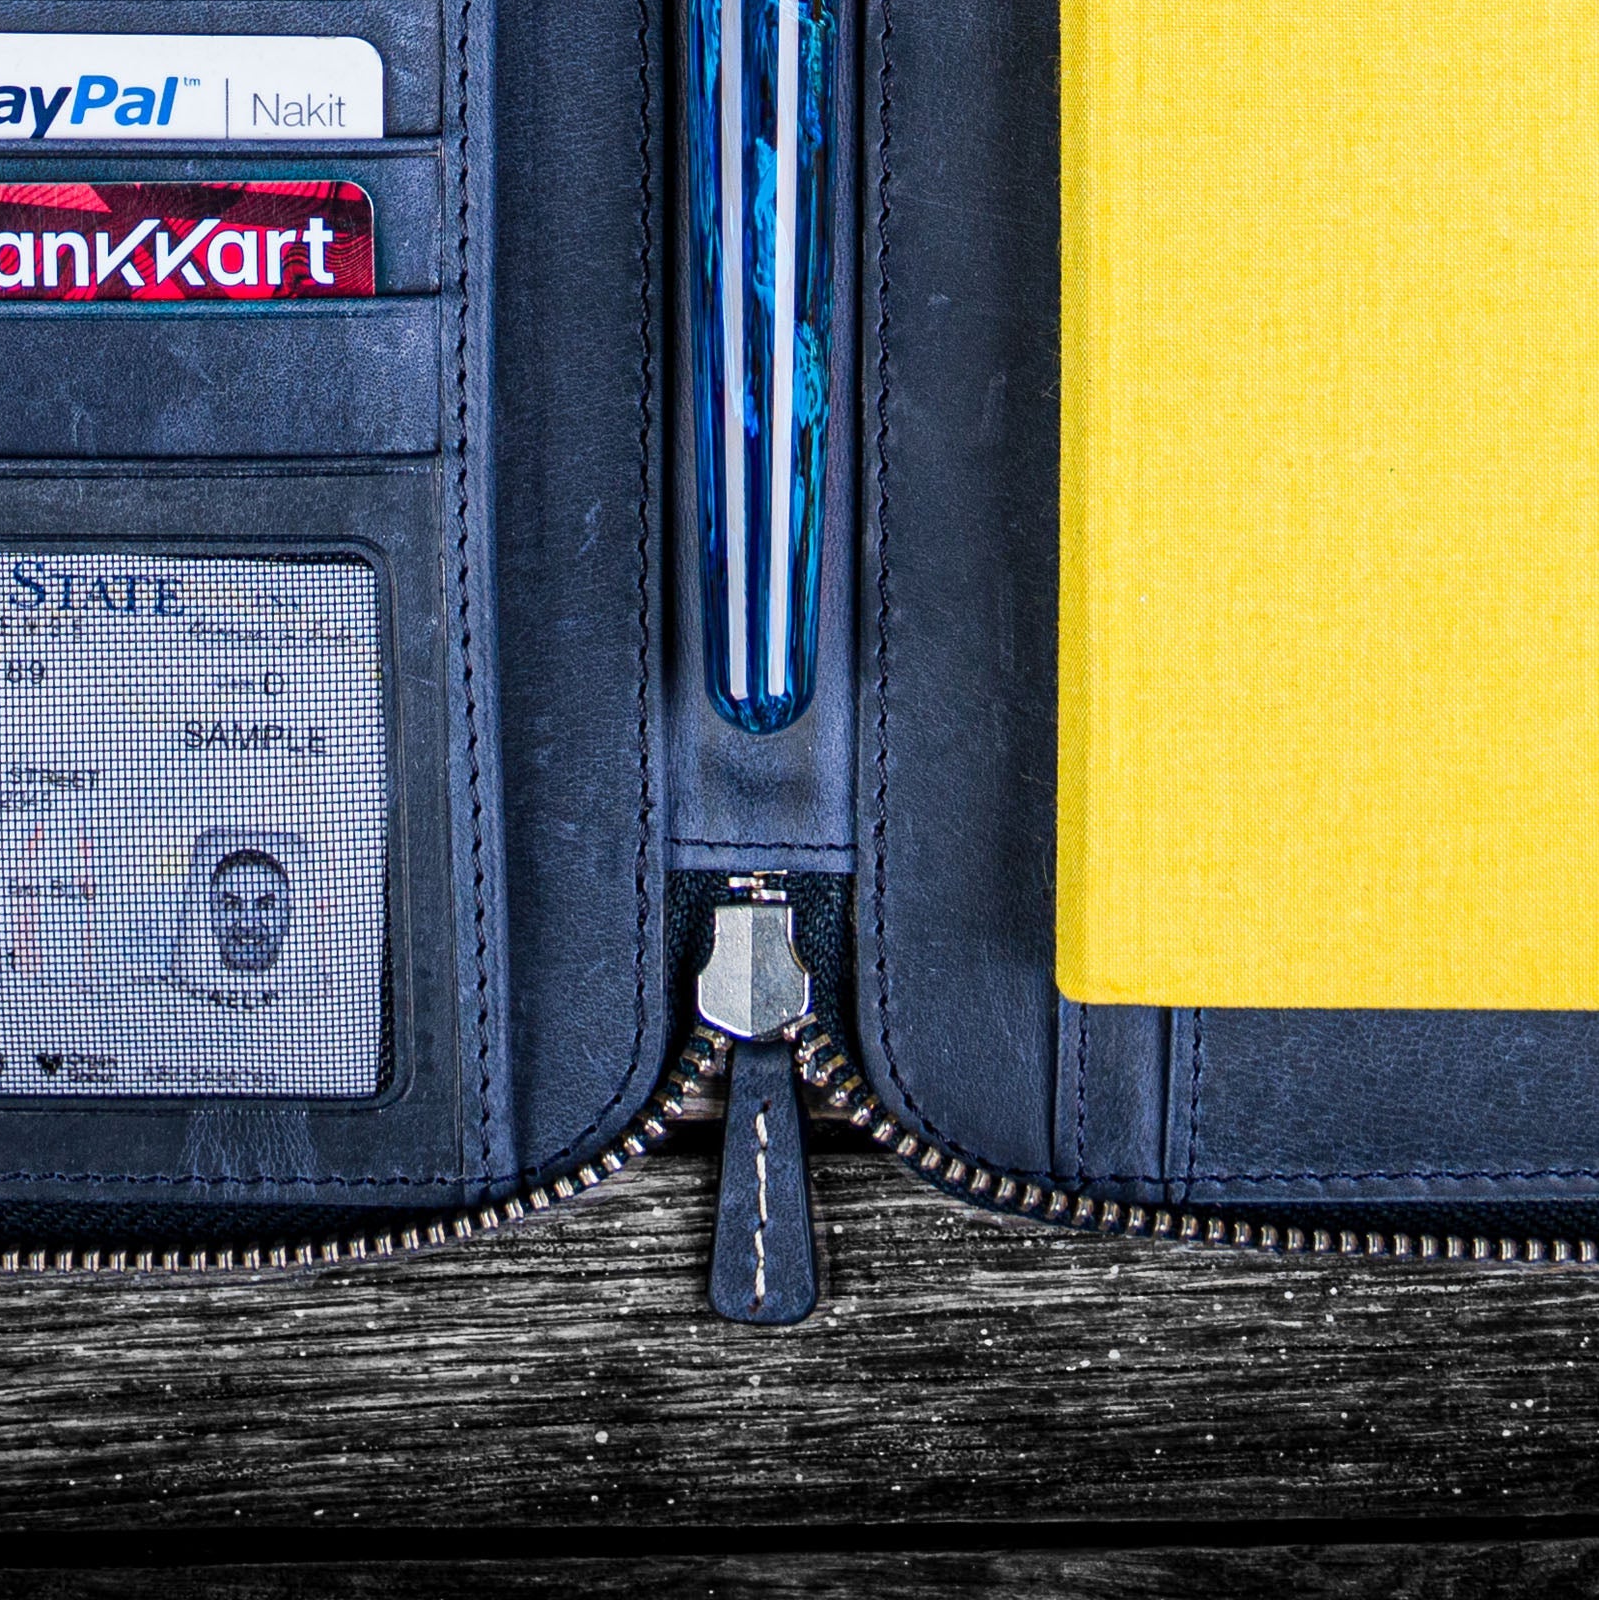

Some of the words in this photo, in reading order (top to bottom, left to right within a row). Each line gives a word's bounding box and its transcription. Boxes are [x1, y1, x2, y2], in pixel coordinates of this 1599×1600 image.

[251, 92, 348, 129] Nakit
[11, 558, 186, 617] STATE
[184, 719, 327, 755] SAMPLE
